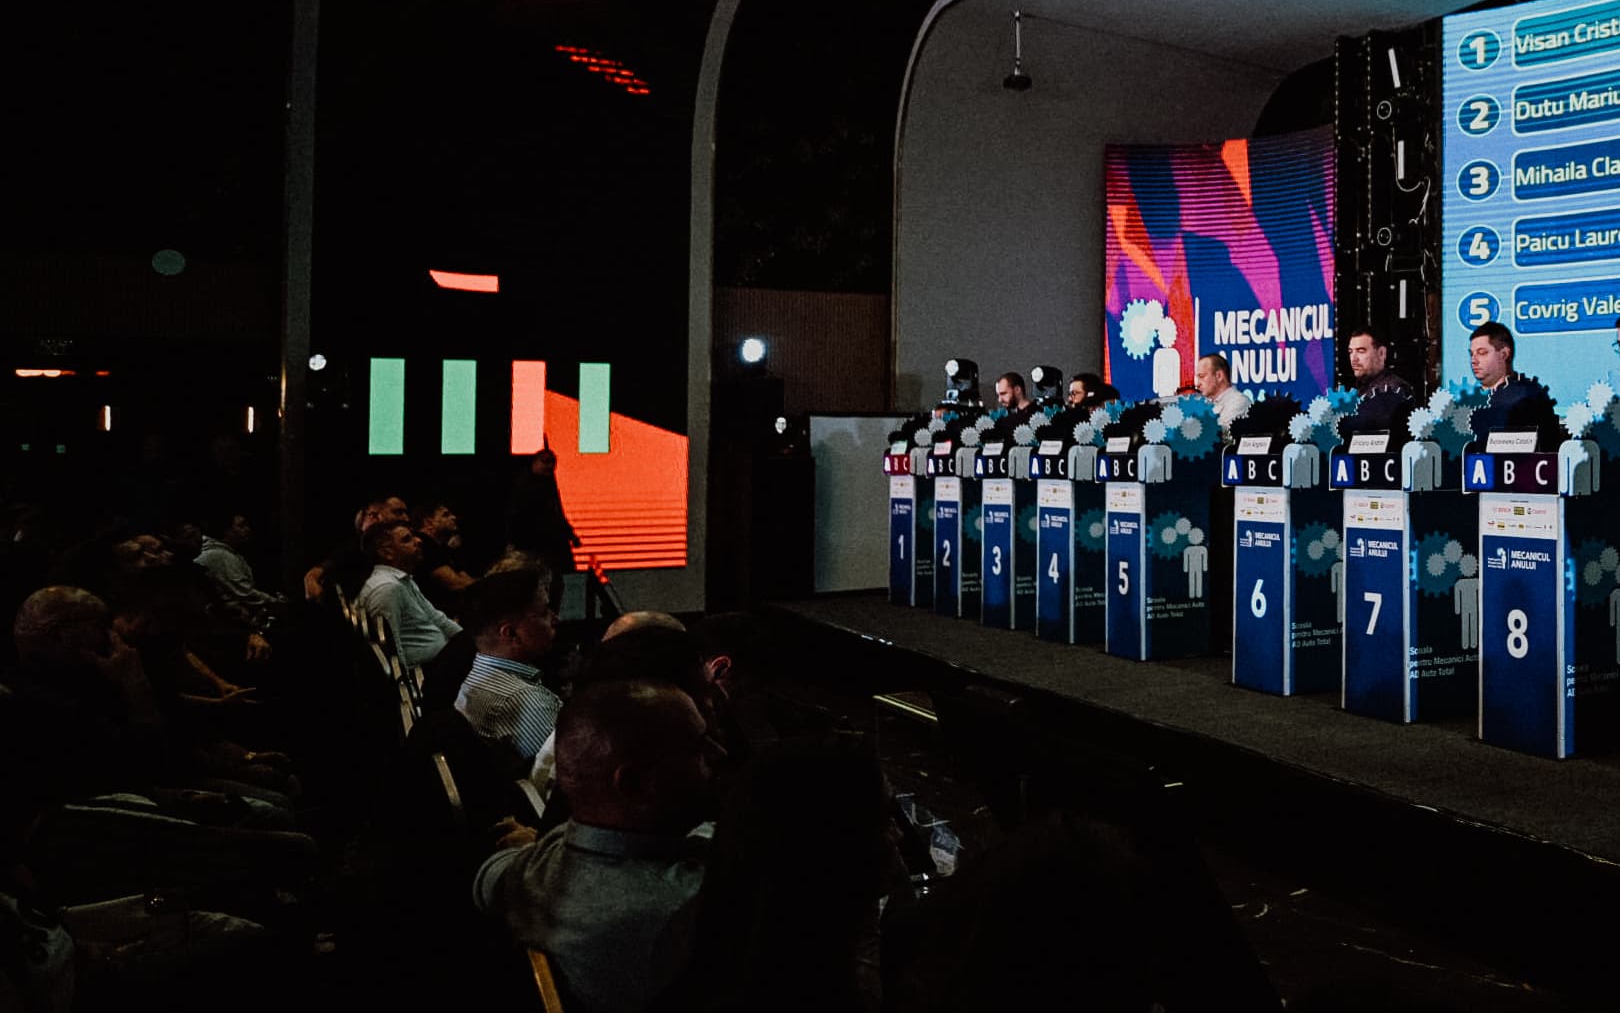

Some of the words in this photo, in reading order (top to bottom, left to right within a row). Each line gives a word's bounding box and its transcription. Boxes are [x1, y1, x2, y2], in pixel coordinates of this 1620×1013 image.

[1469, 36, 1486, 64] 1
[1515, 31, 1570, 54] Visan
[1469, 101, 1490, 130] 2
[1515, 99, 1564, 121] Dutu
[1469, 166, 1489, 195] 3
[1515, 161, 1588, 187] Mihaila
[1468, 232, 1490, 260] 4
[1516, 232, 1570, 253] Paicu
[1214, 303, 1334, 346] MECANICUL
[1469, 298, 1490, 326] 5
[1515, 300, 1579, 322] Covrig
[1219, 347, 1297, 384] NULUI
[976, 458, 984, 475] A
[988, 458, 993, 473] B
[1000, 458, 1006, 473] C
[1031, 457, 1039, 475] A
[1045, 458, 1051, 475] B
[1058, 459, 1064, 475] C
[1099, 459, 1107, 477] A
[1113, 459, 1119, 476] B
[1127, 459, 1134, 477] C
[1227, 459, 1238, 480] A
[1248, 460, 1256, 479] B
[1267, 460, 1277, 480] C
[1336, 459, 1349, 482] A
[1360, 459, 1370, 482] B
[1384, 459, 1395, 482] C
[1472, 460, 1487, 484] A
[1503, 460, 1515, 484] B
[1535, 460, 1548, 486] C
[898, 535, 904, 560] 1
[942, 540, 950, 566] 2
[992, 546, 1001, 575] 3
[1048, 553, 1059, 584] 4
[1118, 561, 1129, 595] 5
[1251, 579, 1267, 618] 6
[1363, 591, 1383, 636] 7
[1506, 608, 1529, 659] 8
